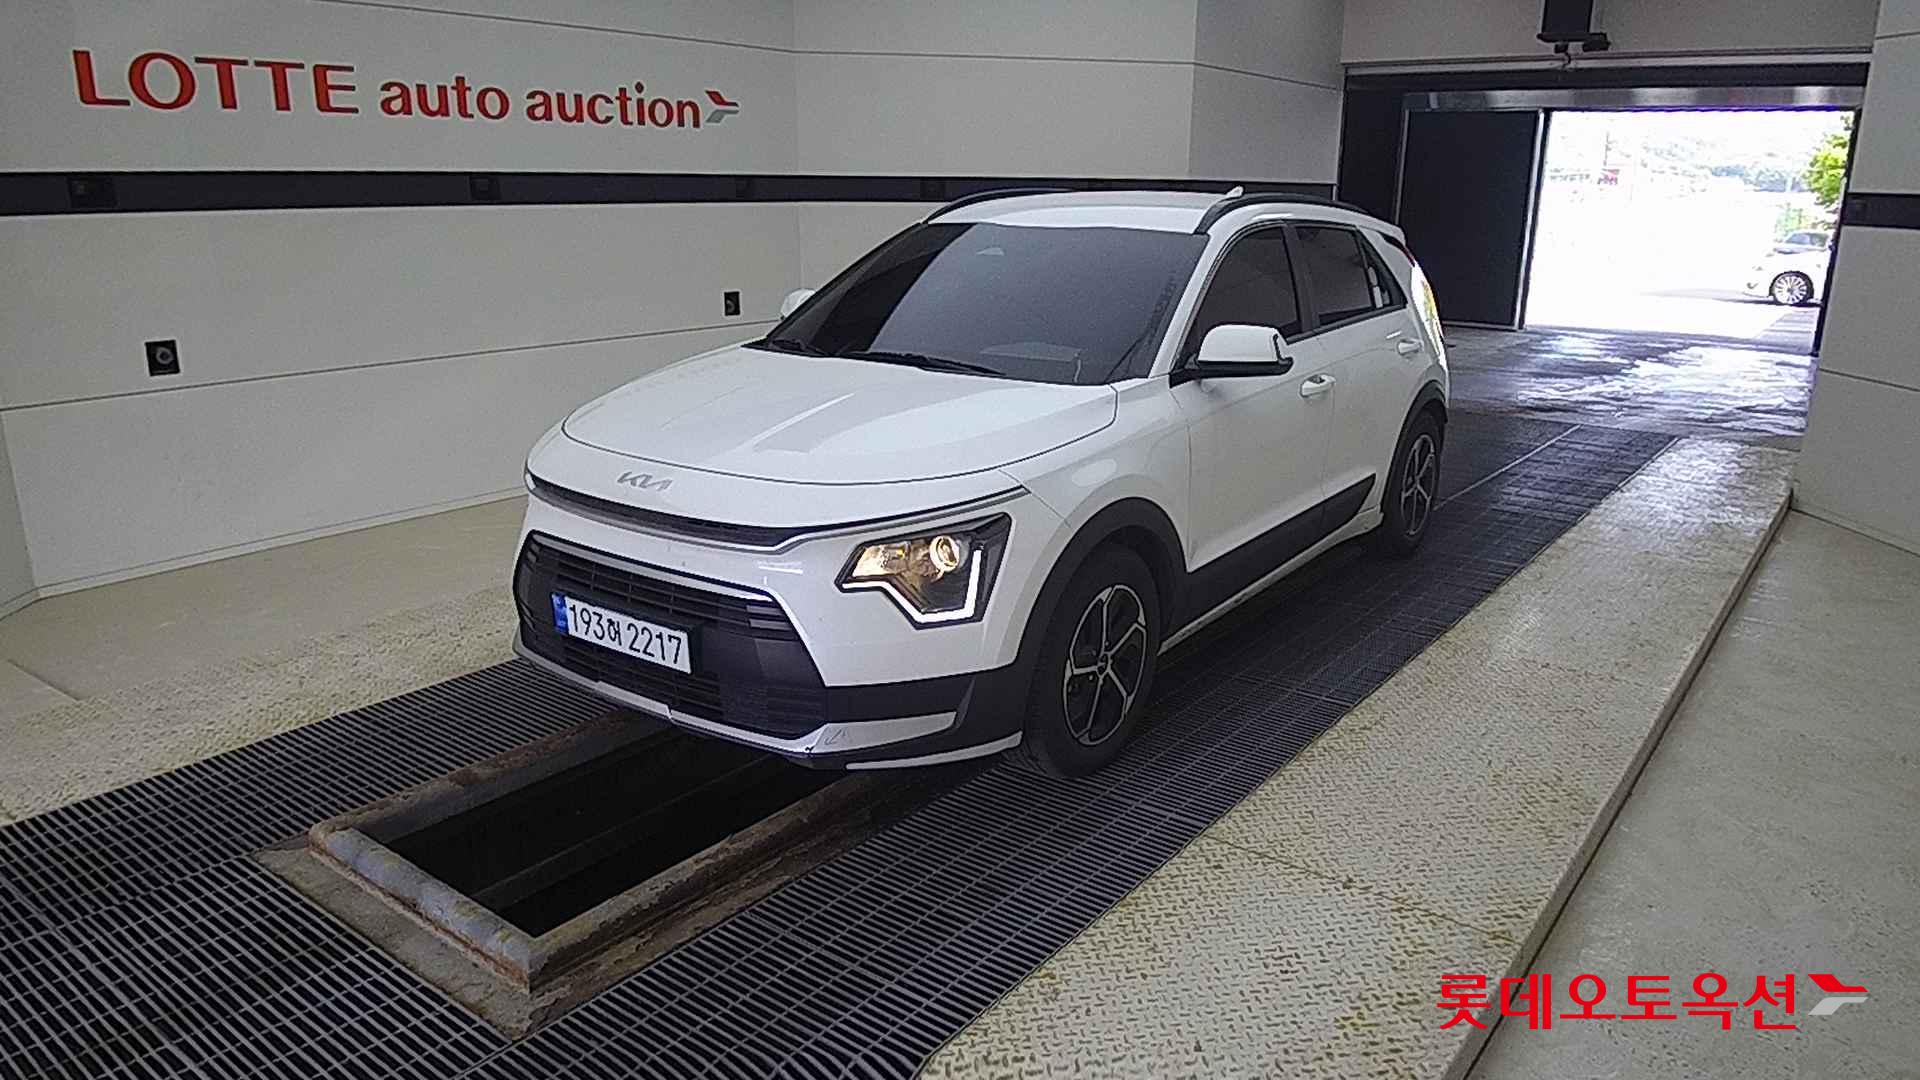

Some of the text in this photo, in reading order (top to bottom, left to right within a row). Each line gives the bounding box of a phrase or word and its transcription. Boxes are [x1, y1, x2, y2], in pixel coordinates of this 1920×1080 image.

[72, 50, 702, 129] LOTTE auto auction
[626, 622, 682, 665] 2217
